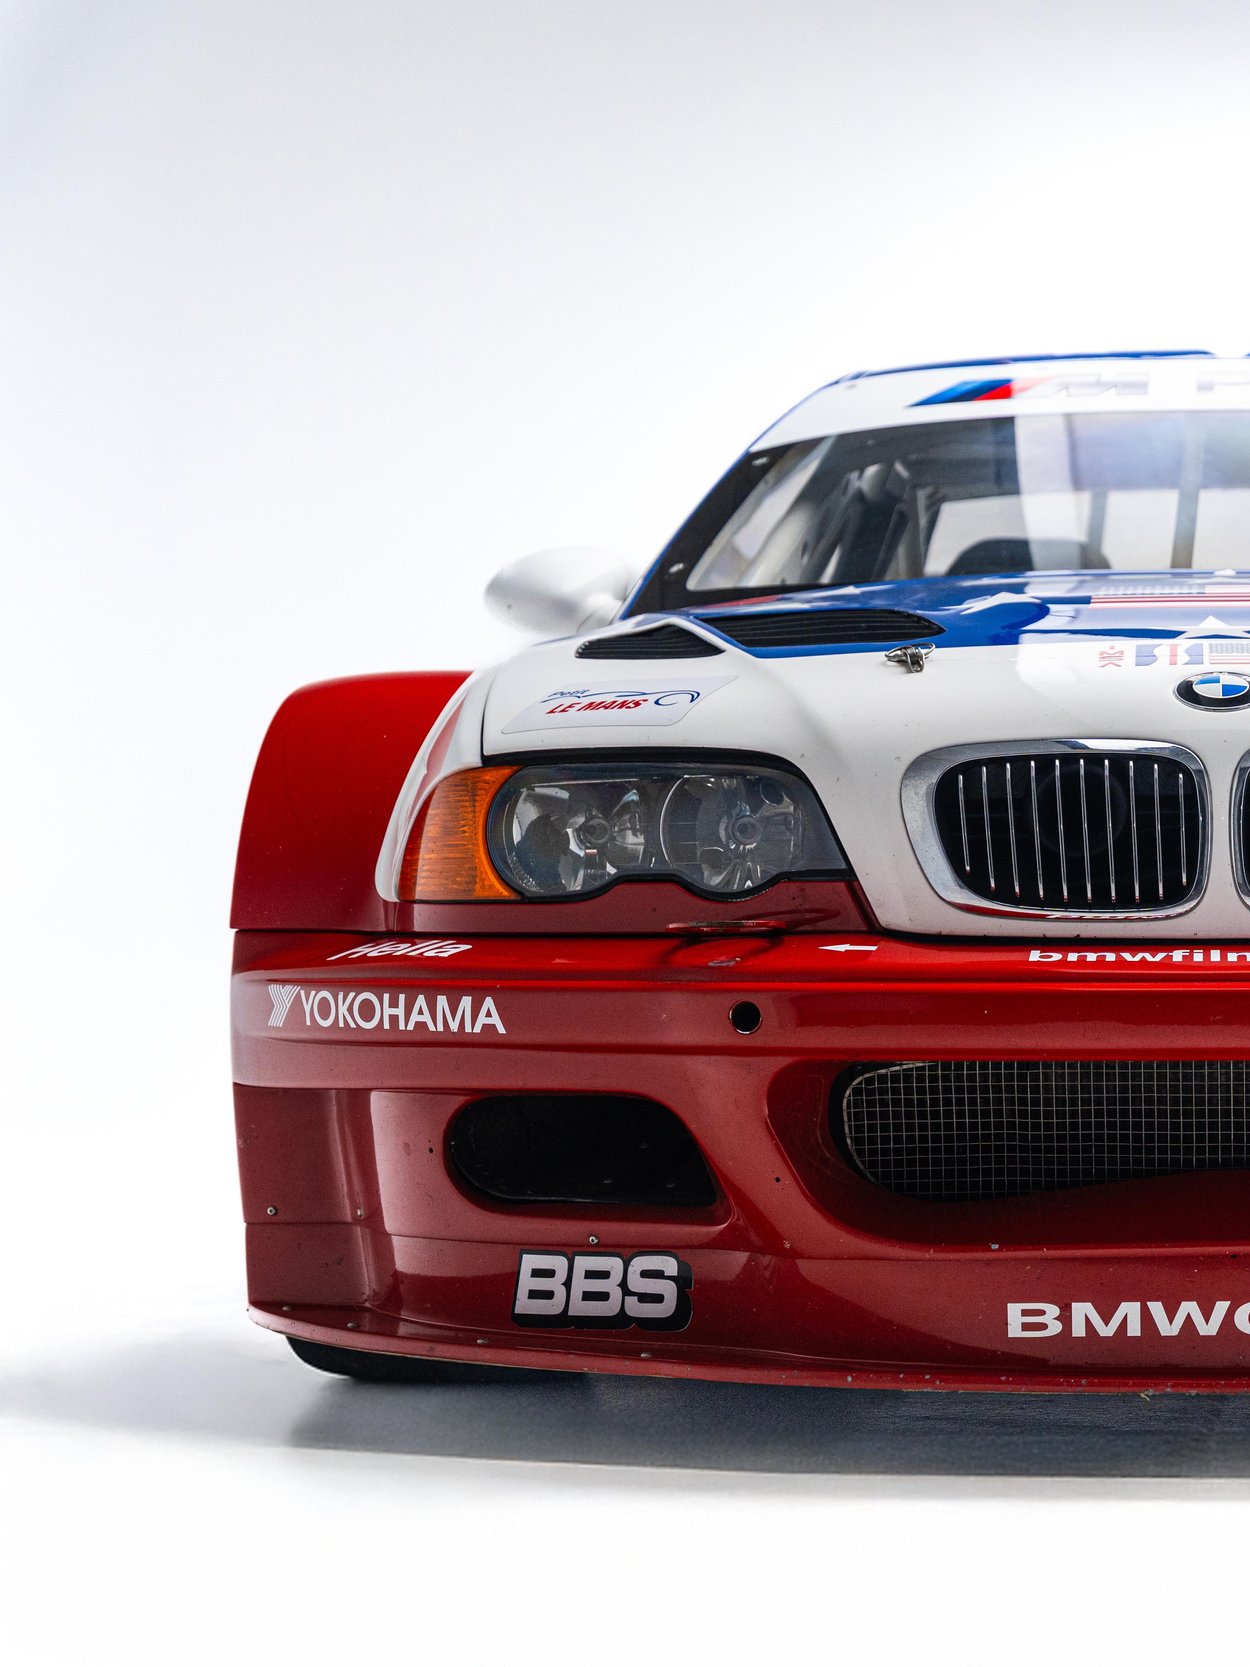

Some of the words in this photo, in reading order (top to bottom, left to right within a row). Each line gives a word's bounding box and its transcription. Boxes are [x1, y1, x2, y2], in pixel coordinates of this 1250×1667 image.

[546, 702, 582, 714] LE
[576, 699, 648, 712] MANS
[326, 941, 474, 961] Hella
[301, 991, 506, 1035] YOKOHAMA
[514, 1253, 678, 1318] BBS
